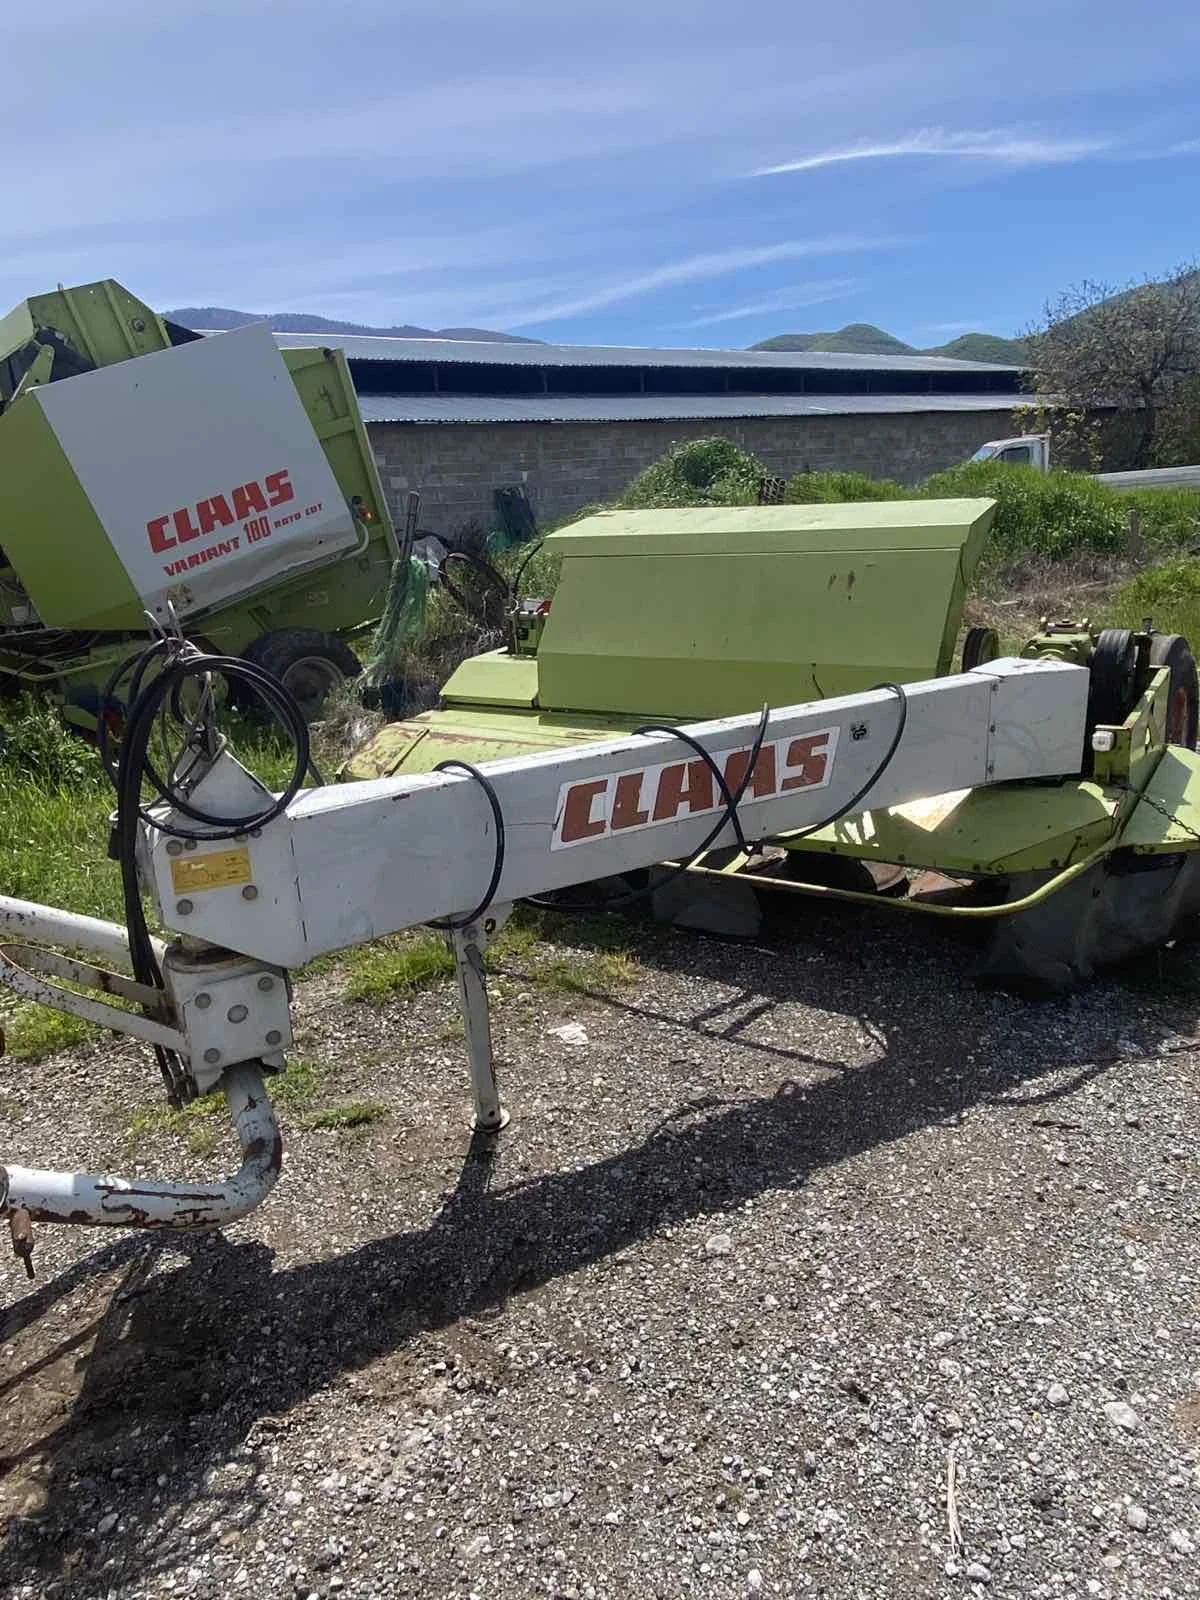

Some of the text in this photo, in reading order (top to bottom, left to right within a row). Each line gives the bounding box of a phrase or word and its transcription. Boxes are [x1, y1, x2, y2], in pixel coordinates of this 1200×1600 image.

[147, 469, 295, 554] CLAAS
[163, 502, 323, 577] VARIANT 180 ROTO CUT
[560, 732, 830, 843] CLAAS
